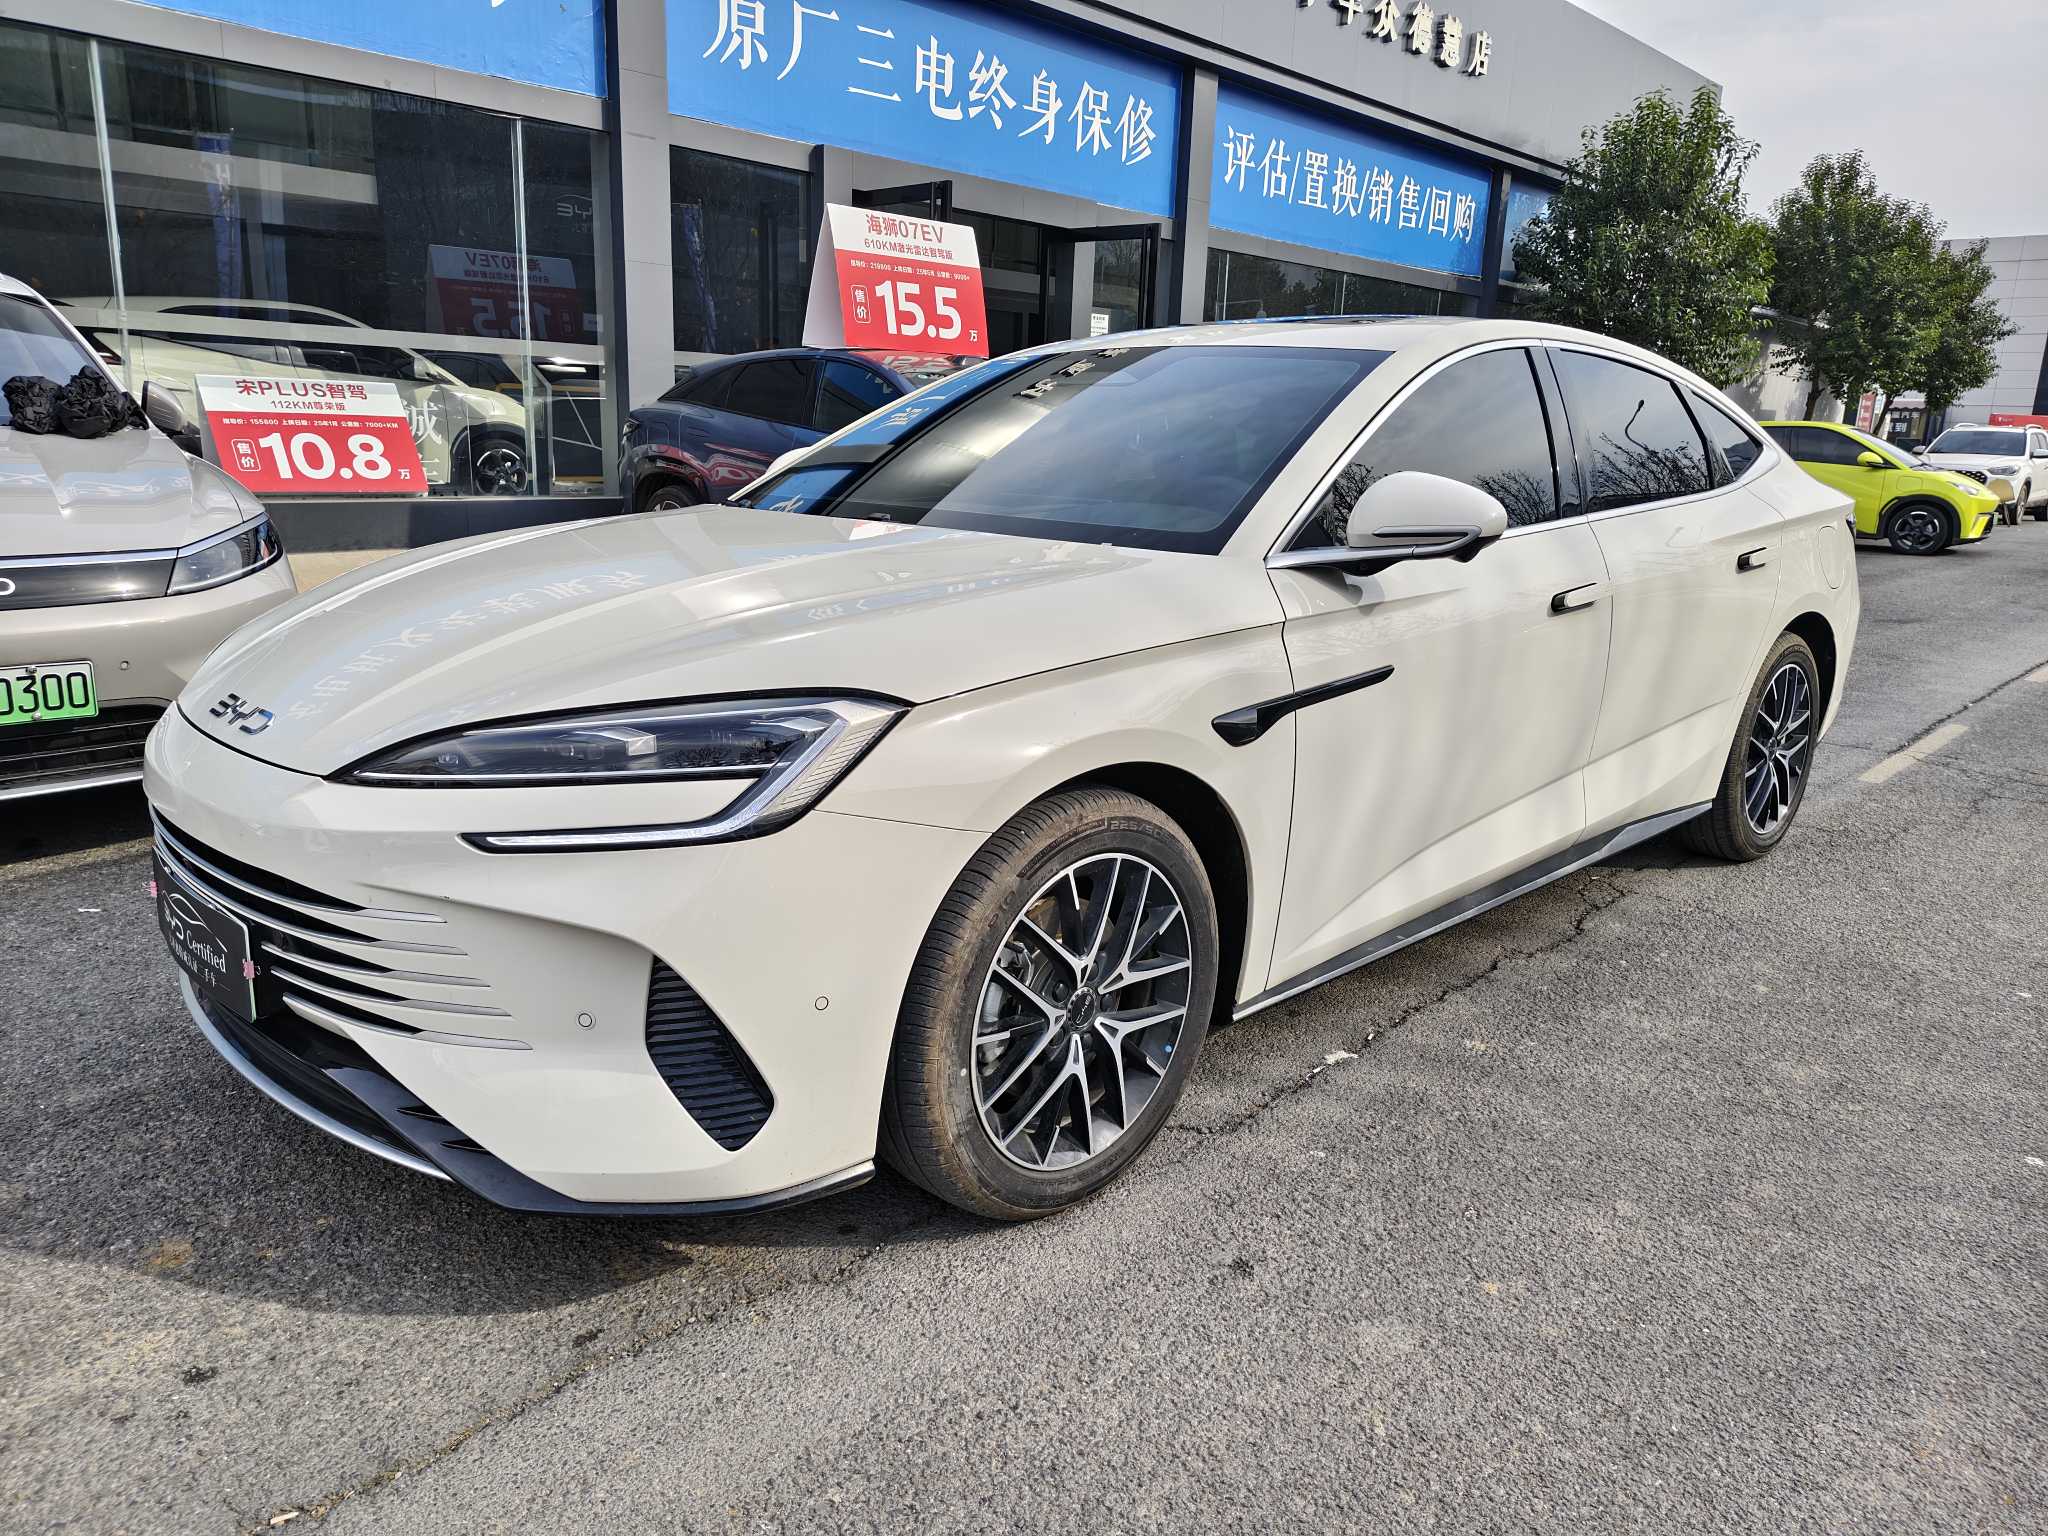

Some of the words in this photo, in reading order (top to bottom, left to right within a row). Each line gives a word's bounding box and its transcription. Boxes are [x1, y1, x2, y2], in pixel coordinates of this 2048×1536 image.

[702, 0, 1157, 166] 原厂三电终身保修
[1223, 125, 1476, 244] 评估/置换/销售/回购
[865, 213, 944, 243] 海狮07EV
[854, 288, 867, 320] 售价
[875, 280, 962, 340] 15.5
[969, 329, 978, 342] 万
[235, 379, 368, 400] 宋PLUS智驾
[236, 442, 257, 469] 售价
[258, 432, 392, 480] 10.8
[398, 469, 410, 480] 万
[209, 693, 275, 736] BYD
[186, 929, 227, 975] Certified
